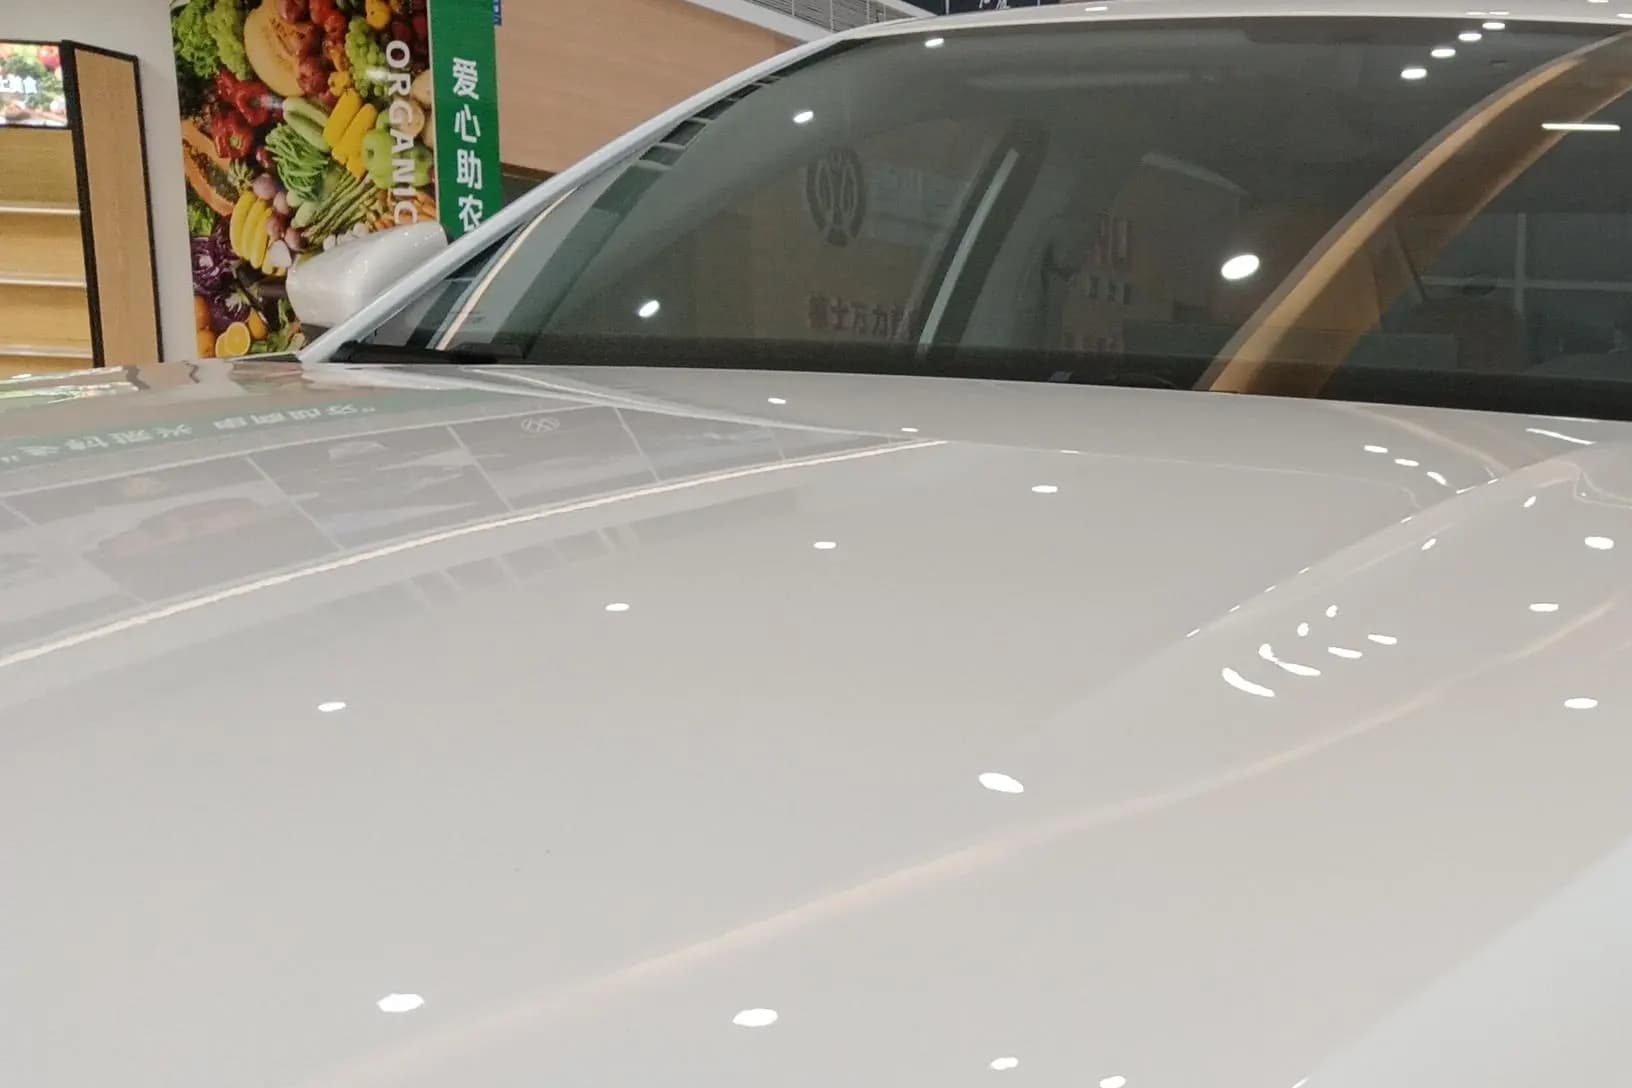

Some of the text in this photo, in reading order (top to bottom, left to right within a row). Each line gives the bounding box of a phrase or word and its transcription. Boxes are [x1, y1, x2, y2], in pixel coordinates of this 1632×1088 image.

[386, 40, 418, 225] ORGANIC
[452, 57, 483, 233] 爱心助农
